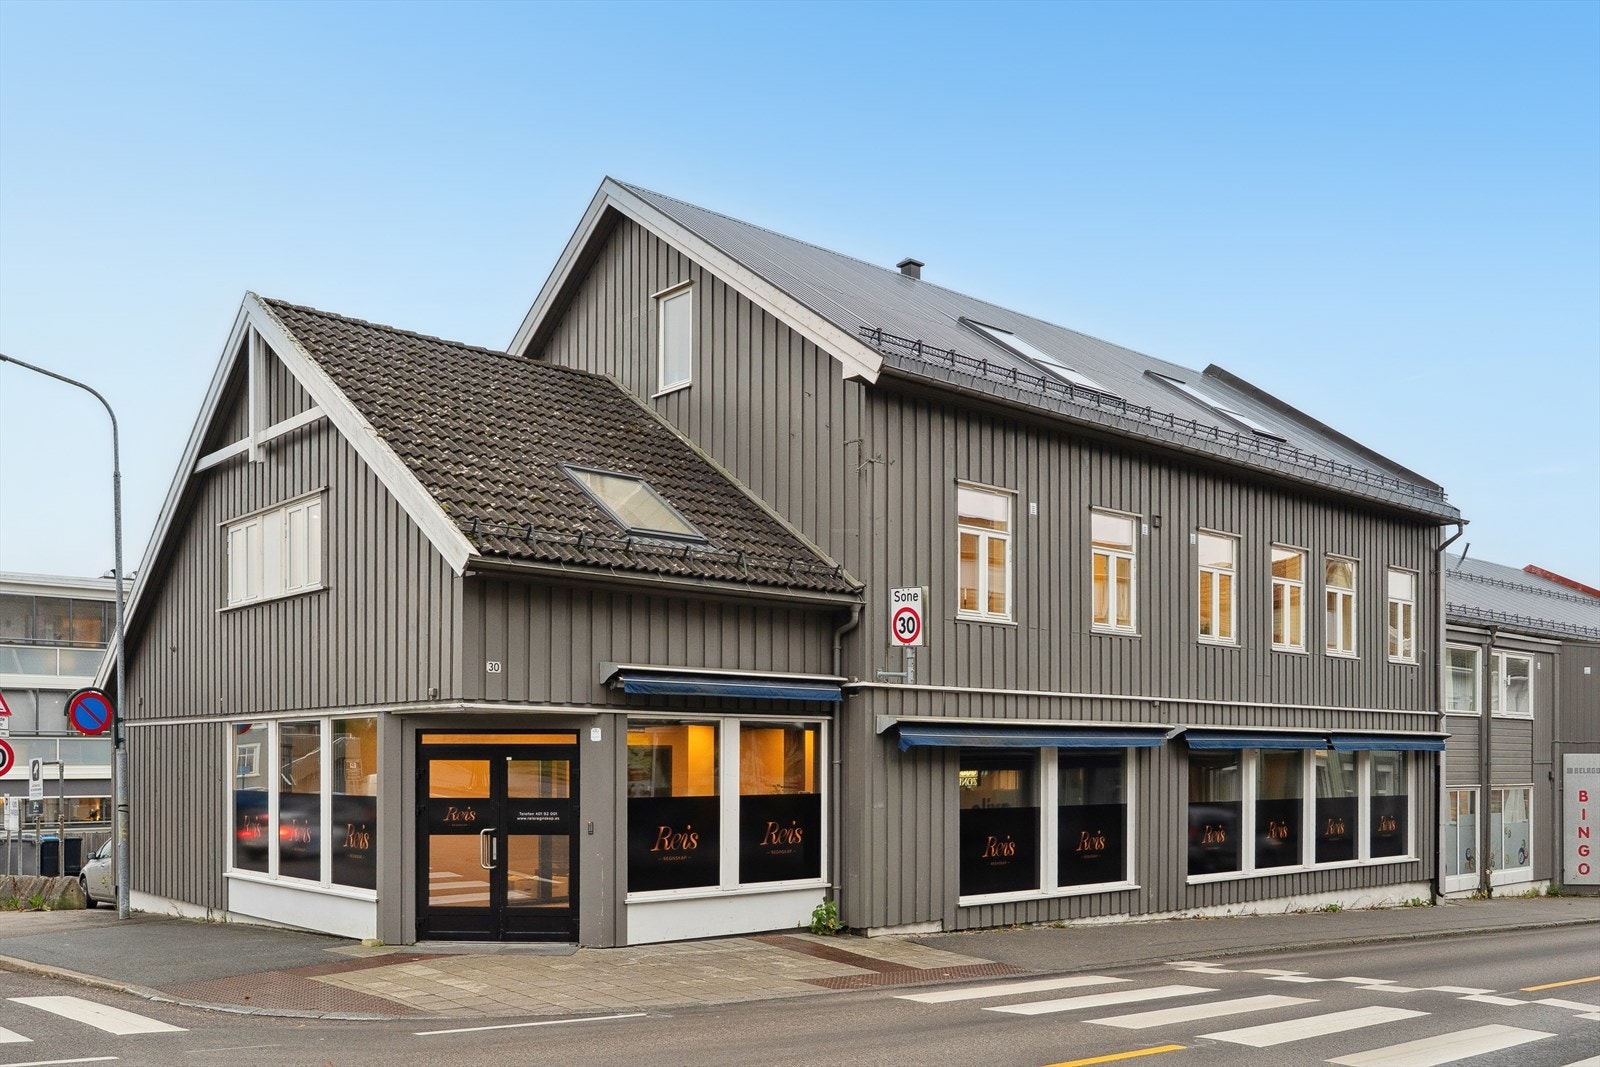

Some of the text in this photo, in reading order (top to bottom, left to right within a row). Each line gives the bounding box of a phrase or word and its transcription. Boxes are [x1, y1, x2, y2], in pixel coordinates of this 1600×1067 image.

[894, 590, 919, 602] Sone
[898, 616, 915, 634] 30
[488, 662, 500, 672] 30
[0, 748, 7, 768] 0
[443, 806, 478, 822] Reis
[1377, 815, 1397, 832] Reis
[759, 820, 803, 846] Reis
[1201, 824, 1226, 844] Reis
[1266, 821, 1289, 839] Reis
[1325, 817, 1345, 835] Reis
[1578, 790, 1590, 875] BINGO
[343, 823, 370, 850] Reis
[650, 824, 698, 852] Reis
[981, 835, 1015, 858] Reis
[1076, 830, 1106, 852] Reis
